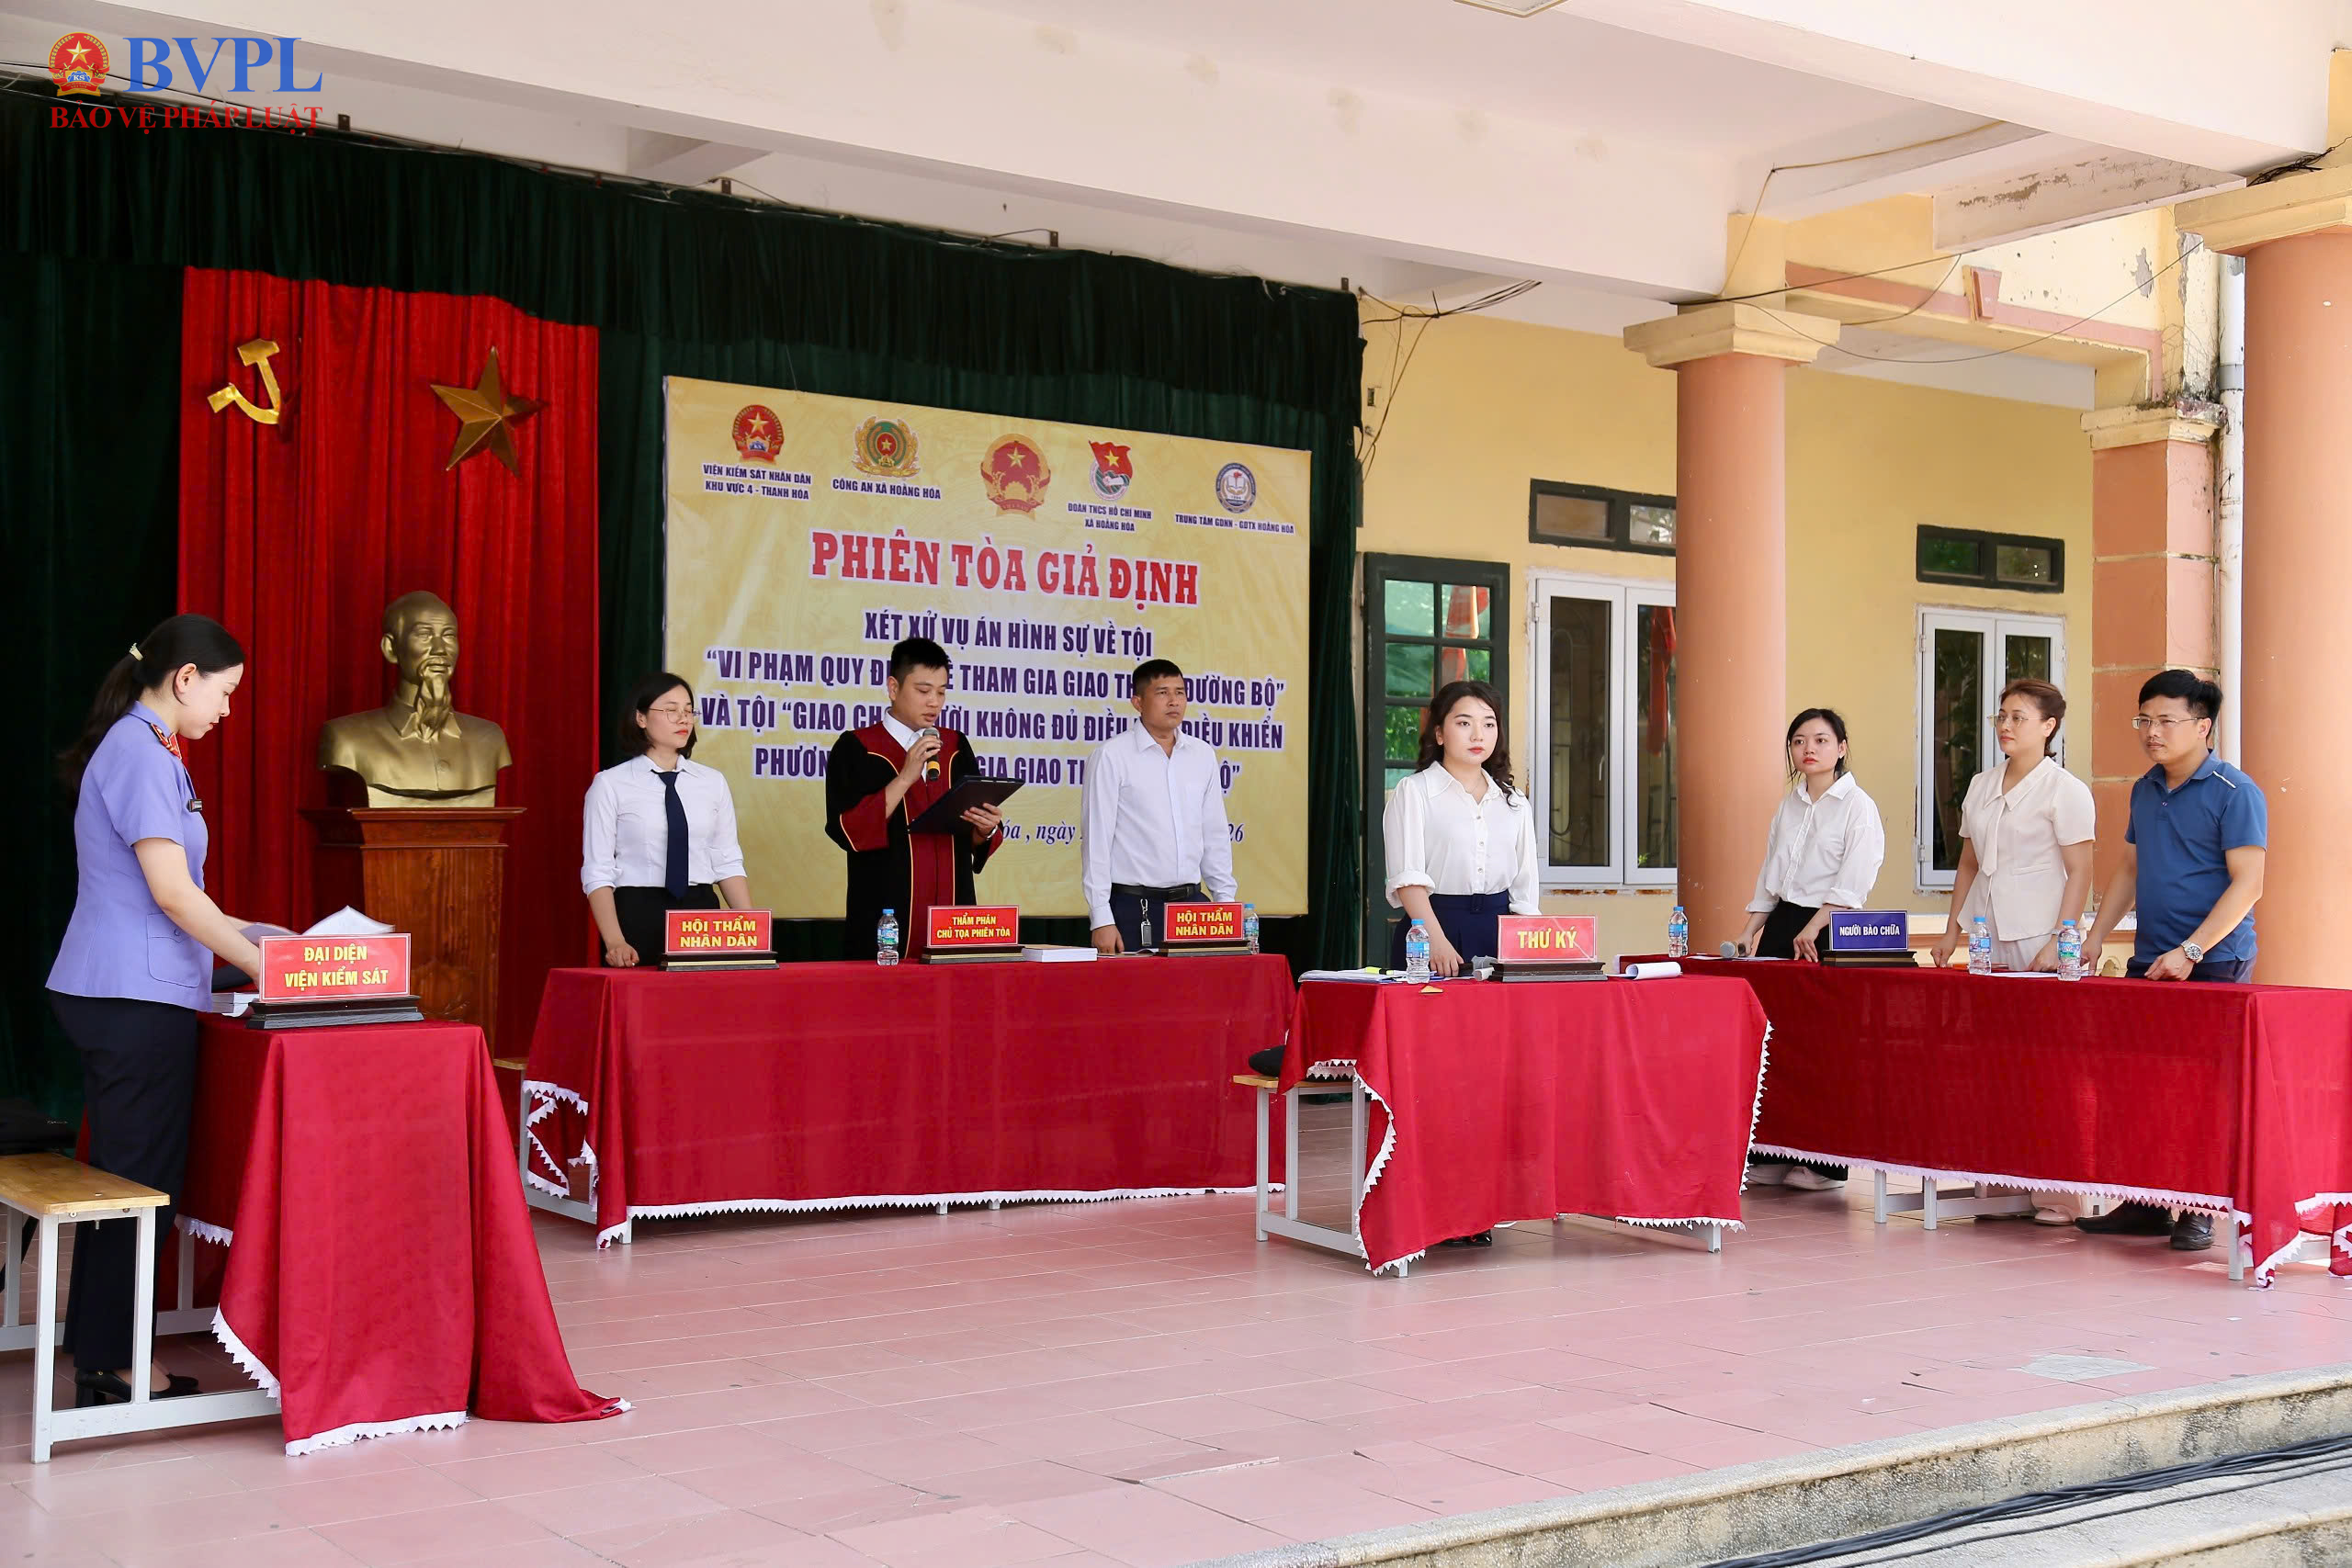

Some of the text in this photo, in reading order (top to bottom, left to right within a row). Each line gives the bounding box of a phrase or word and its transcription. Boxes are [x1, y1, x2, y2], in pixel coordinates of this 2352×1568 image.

[703, 465, 723, 476] VIỆN
[750, 468, 766, 479] SÁT
[769, 471, 791, 482] NHÂN
[794, 474, 811, 484] DÂN
[706, 481, 723, 491] KHU
[726, 483, 744, 494] VỰC
[747, 485, 753, 493] 4
[761, 486, 789, 497] THANH
[833, 478, 858, 491] CÔNG
[861, 482, 873, 492] AN
[1134, 510, 1152, 519] MINH
[1176, 514, 1197, 524] TRUNG
[813, 529, 1197, 610] PHIÊN TÒA GIẢ ĐỊNH
[865, 609, 1152, 660] XÉT XỬ VỤ ÁN HÌNH SỰ VỀ TỘI
[749, 652, 813, 686] PHẠM
[821, 656, 864, 686] QUY
[960, 664, 1016, 693] THAM
[1024, 668, 1057, 695] GIA
[1064, 671, 1108, 698] GIAO
[701, 695, 731, 726] VÀ
[738, 695, 775, 733] TỘI
[853, 705, 889, 729] CH
[936, 705, 969, 736] ƯỜI
[977, 708, 1045, 739] KHÔNG
[1052, 709, 1077, 740] ĐỦ
[1229, 716, 1283, 749] KHIỂN
[756, 745, 830, 777] PHƯƠN
[1015, 757, 1061, 785] GIAO
[1003, 819, 1021, 839] óa
[1036, 821, 1075, 845] ngày
[682, 915, 756, 934] HỘI THẨM
[952, 912, 996, 925] THẨM PHÁN
[1176, 908, 1233, 925] HỘI THẨM
[937, 926, 952, 938] CHỦ
[972, 926, 994, 937] PHIÊN
[1176, 924, 1233, 936] NHÂN DÂN
[1517, 926, 1577, 948] THƯ KÝ
[1840, 924, 1861, 936] NGƯỜI
[1880, 924, 1900, 936] CHỮA
[680, 933, 758, 948] NHÂN DÂN
[304, 943, 367, 965] ĐẠI DIỆN
[285, 966, 389, 991] VIỆN KIỂM SÁT
